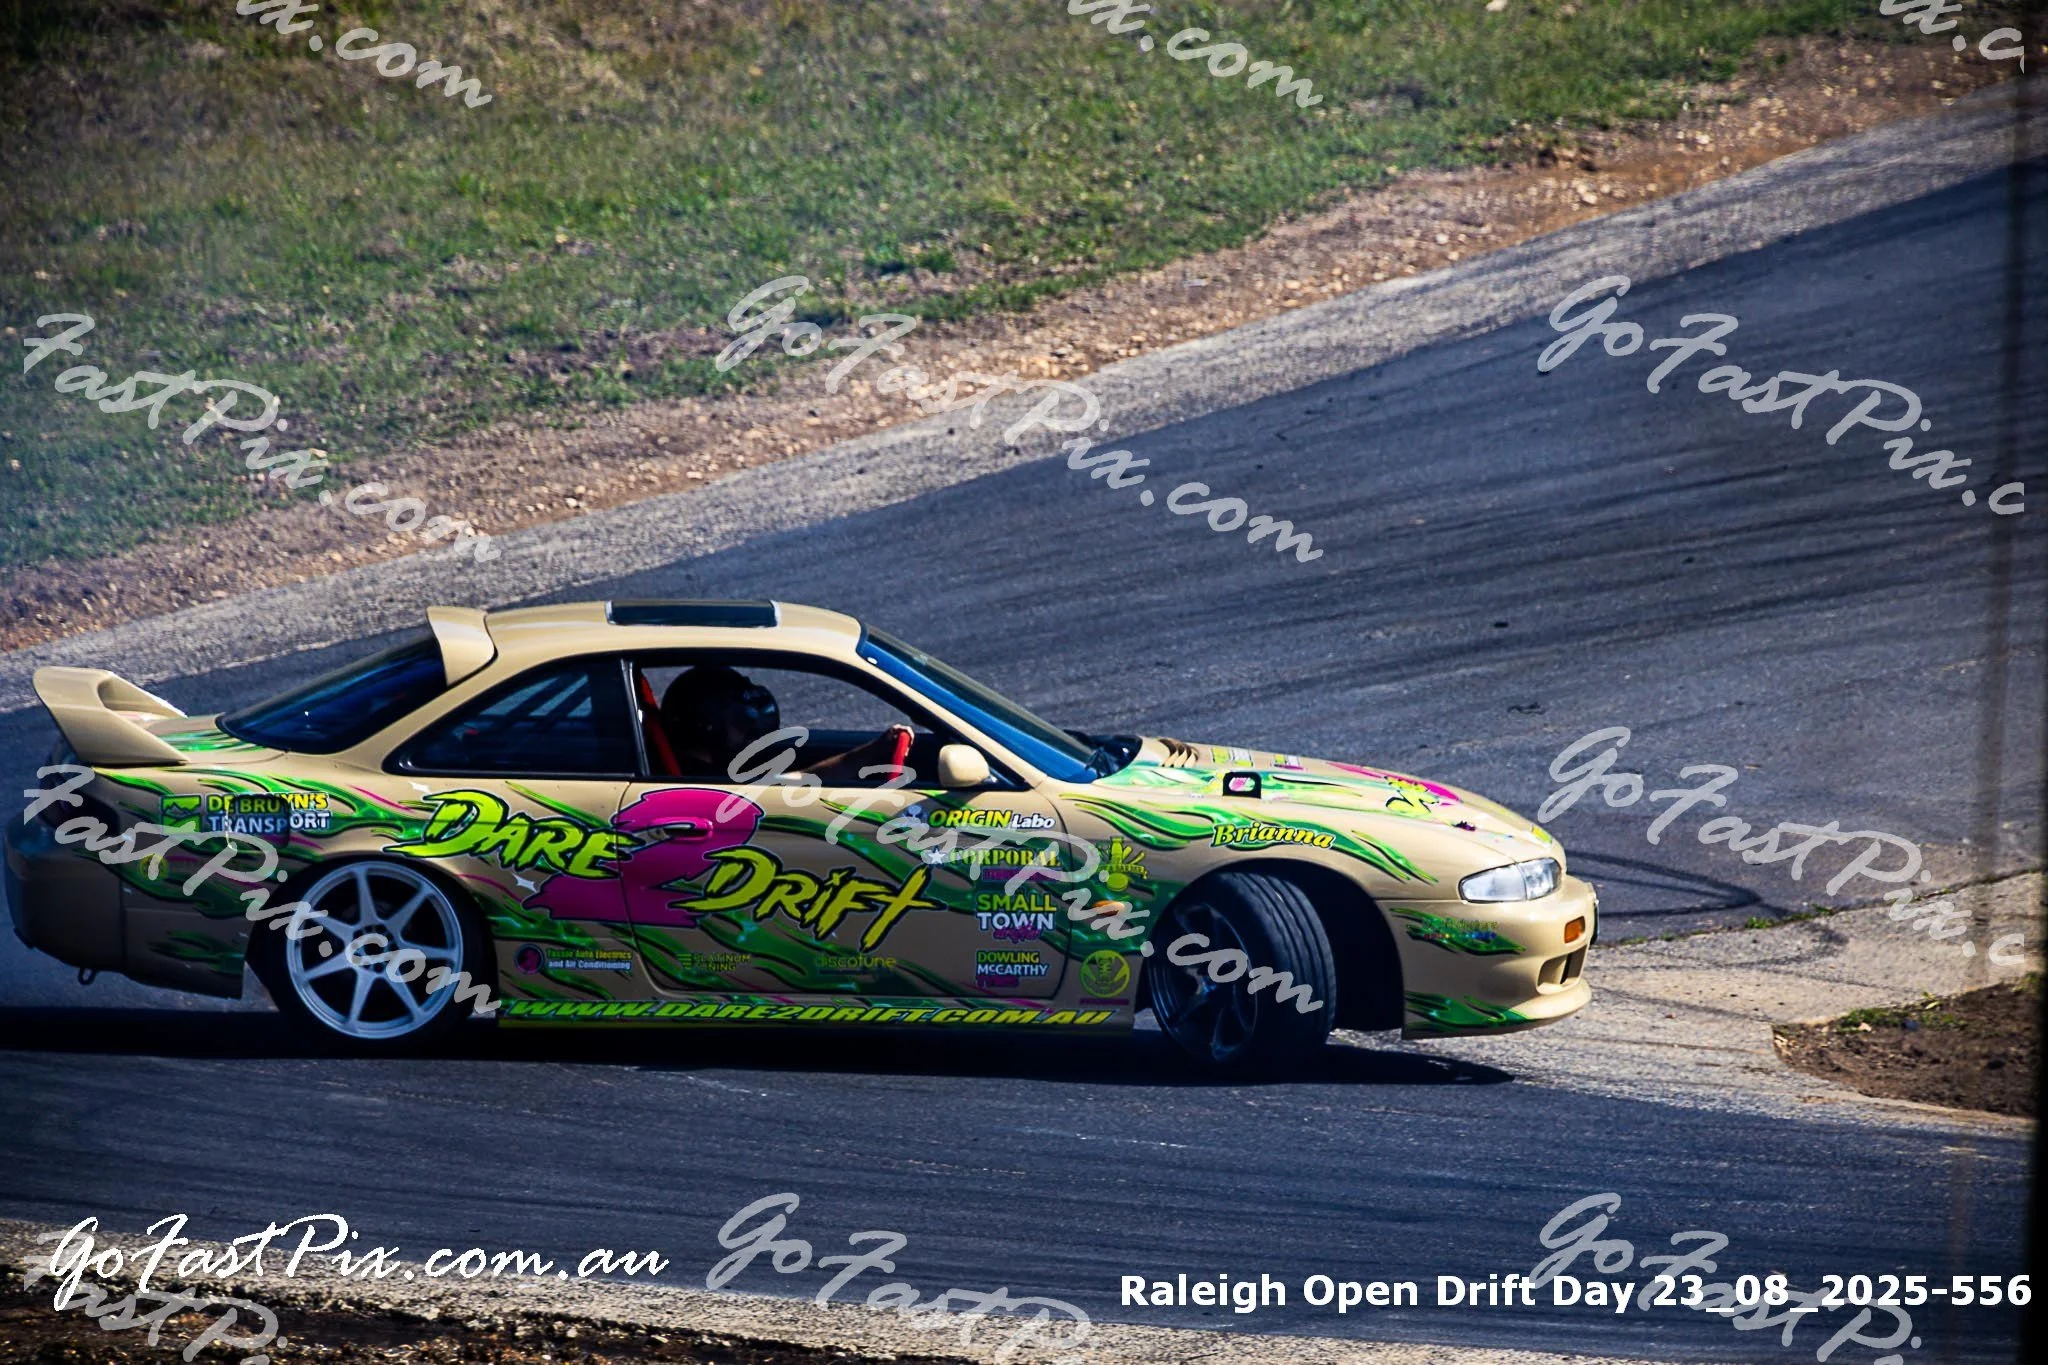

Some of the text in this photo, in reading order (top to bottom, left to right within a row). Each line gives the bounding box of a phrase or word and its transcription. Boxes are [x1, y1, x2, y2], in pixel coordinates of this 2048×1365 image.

[207, 794, 235, 813] DE
[208, 812, 331, 833] TRANSPORT
[928, 809, 1057, 829] ORIGIN Labo
[1211, 823, 1336, 849] Brianna
[523, 788, 765, 927] 2
[977, 893, 1057, 912] SMALL
[977, 912, 1055, 930] TOWN
[977, 951, 1040, 963] DOWLING
[508, 1000, 1113, 1024] WWW.DARE2DRIFT.COM.AU
